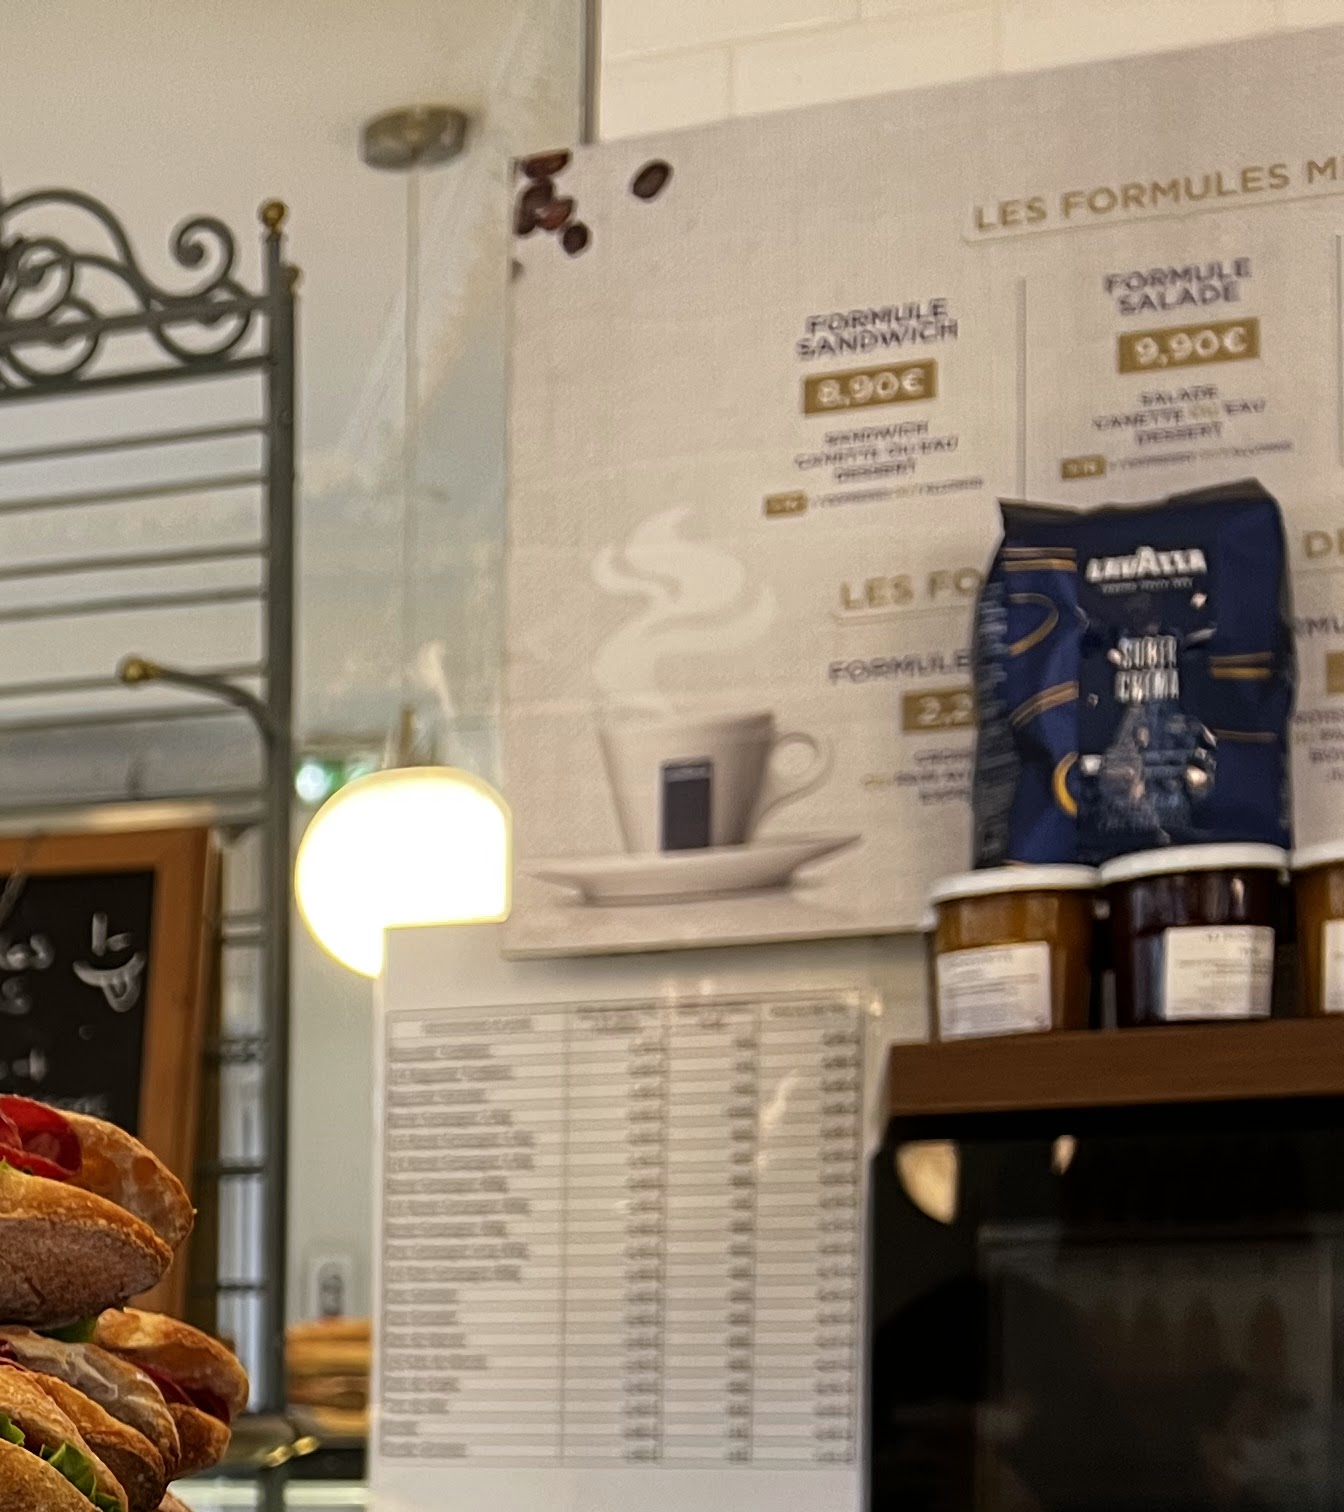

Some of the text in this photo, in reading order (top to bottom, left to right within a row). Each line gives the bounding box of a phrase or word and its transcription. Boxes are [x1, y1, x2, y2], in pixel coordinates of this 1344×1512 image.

[974, 156, 1344, 233] LES FORMULES M
[1103, 256, 1252, 294] FORMULE
[805, 298, 949, 333] FORMULE
[1117, 281, 1240, 316] SALADE
[795, 319, 959, 361] SANDWICH
[1133, 326, 1249, 367] 9,90€
[840, 573, 915, 611] LES
